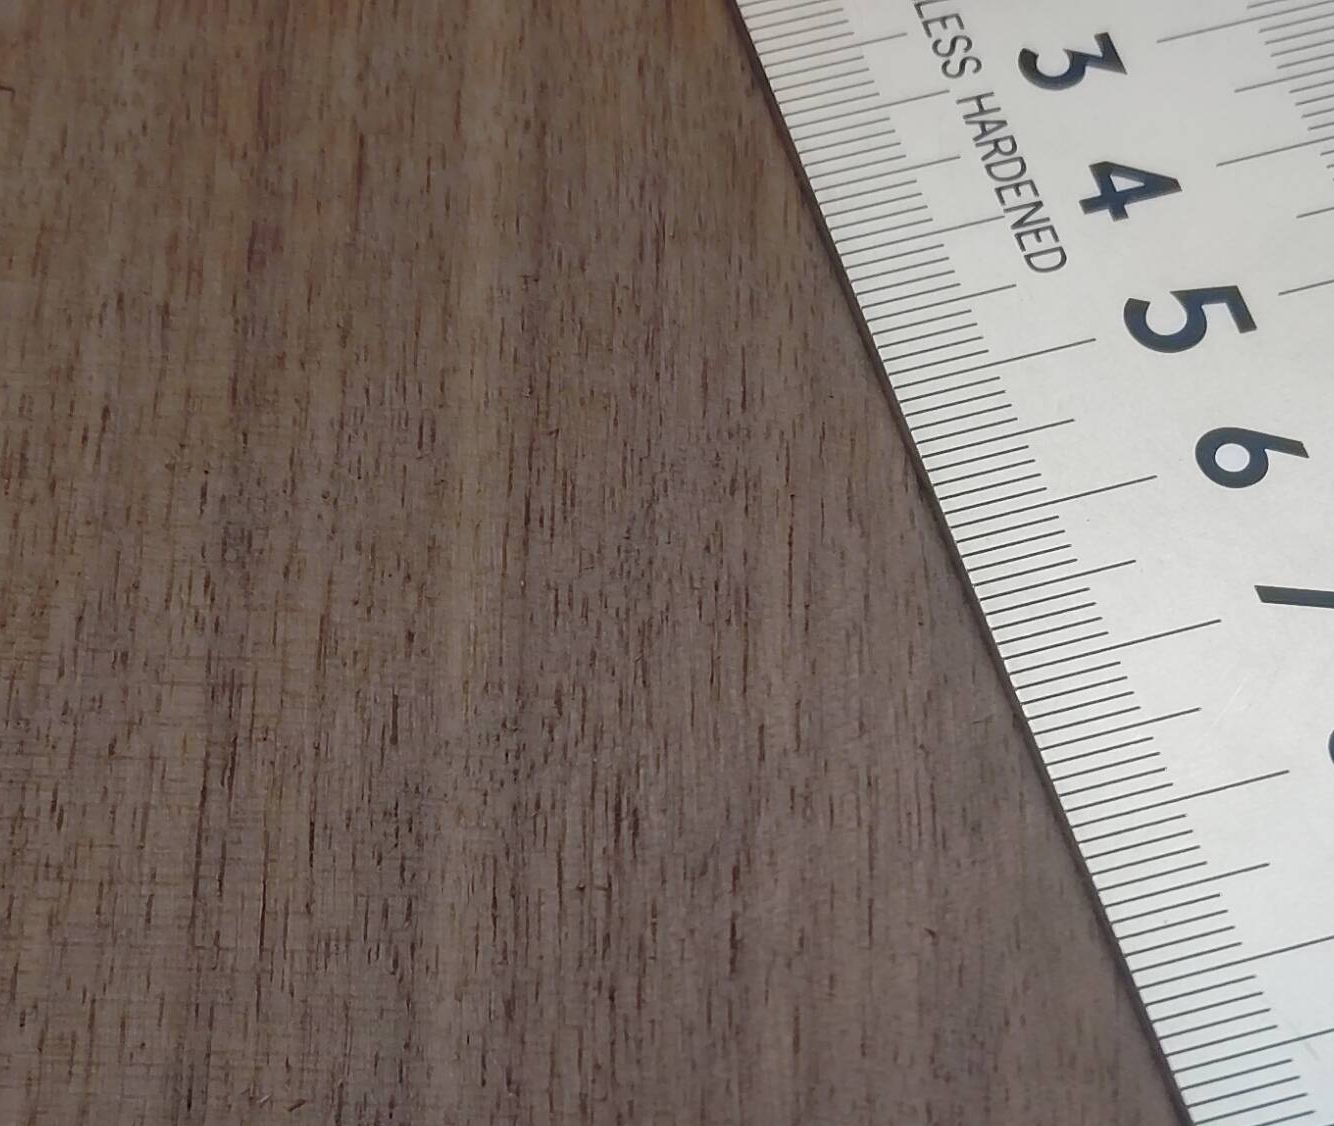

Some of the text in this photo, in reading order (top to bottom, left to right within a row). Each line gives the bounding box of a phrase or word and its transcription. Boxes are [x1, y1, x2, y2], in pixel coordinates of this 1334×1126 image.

[1017, 32, 1127, 90] 3
[957, 92, 1067, 273] HARDENED
[1078, 160, 1182, 221] 4
[1123, 285, 1257, 353] 5
[1195, 427, 1309, 488] 6
